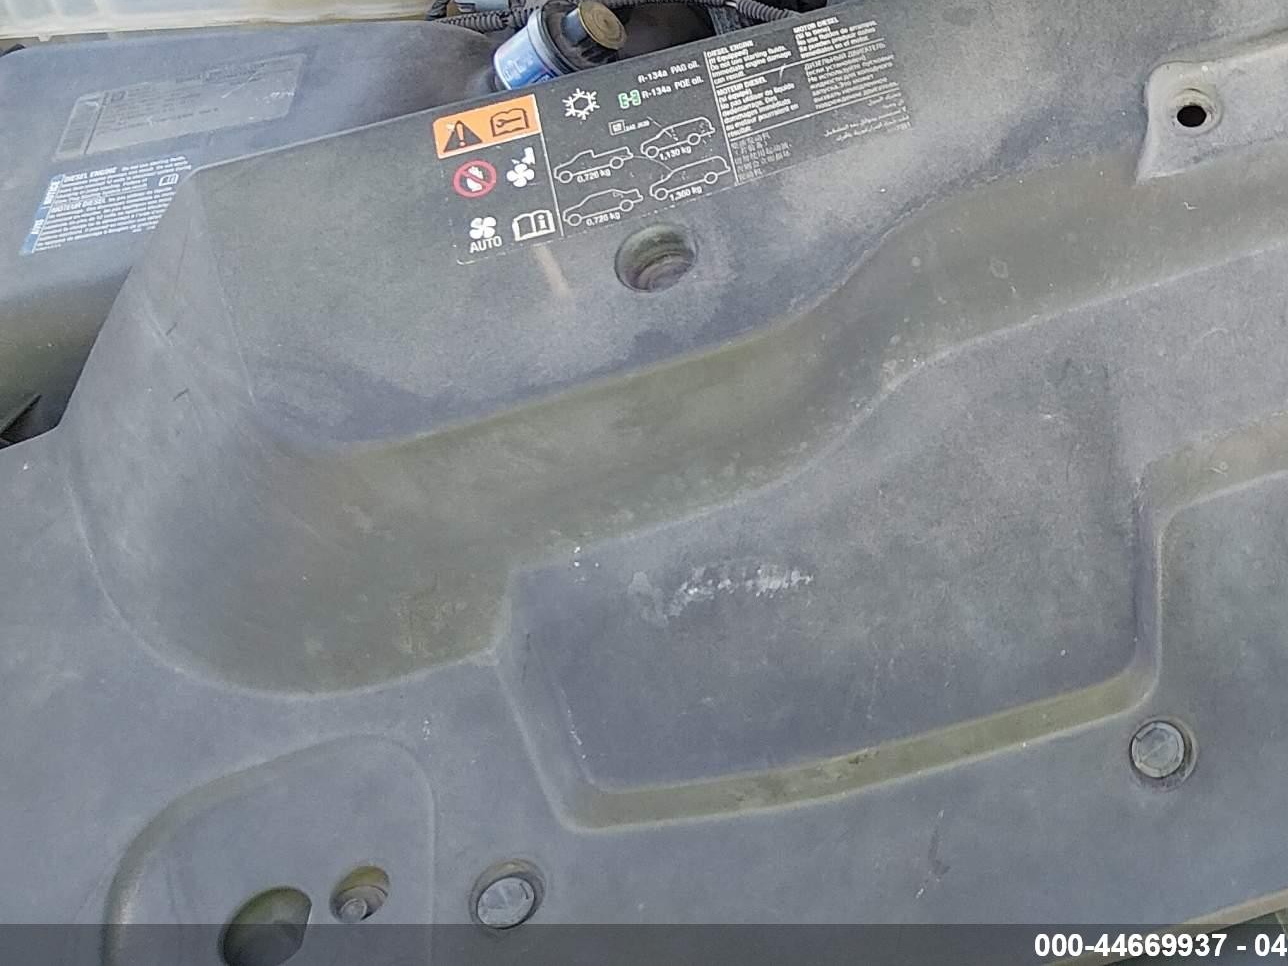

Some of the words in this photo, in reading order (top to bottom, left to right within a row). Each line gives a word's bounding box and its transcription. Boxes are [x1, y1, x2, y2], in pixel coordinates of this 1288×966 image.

[707, 47, 728, 57] DIESEL
[729, 40, 753, 51] ENGINE
[638, 69, 668, 83] R-134a
[641, 85, 672, 99] R-134a
[470, 235, 503, 254] AUTO
